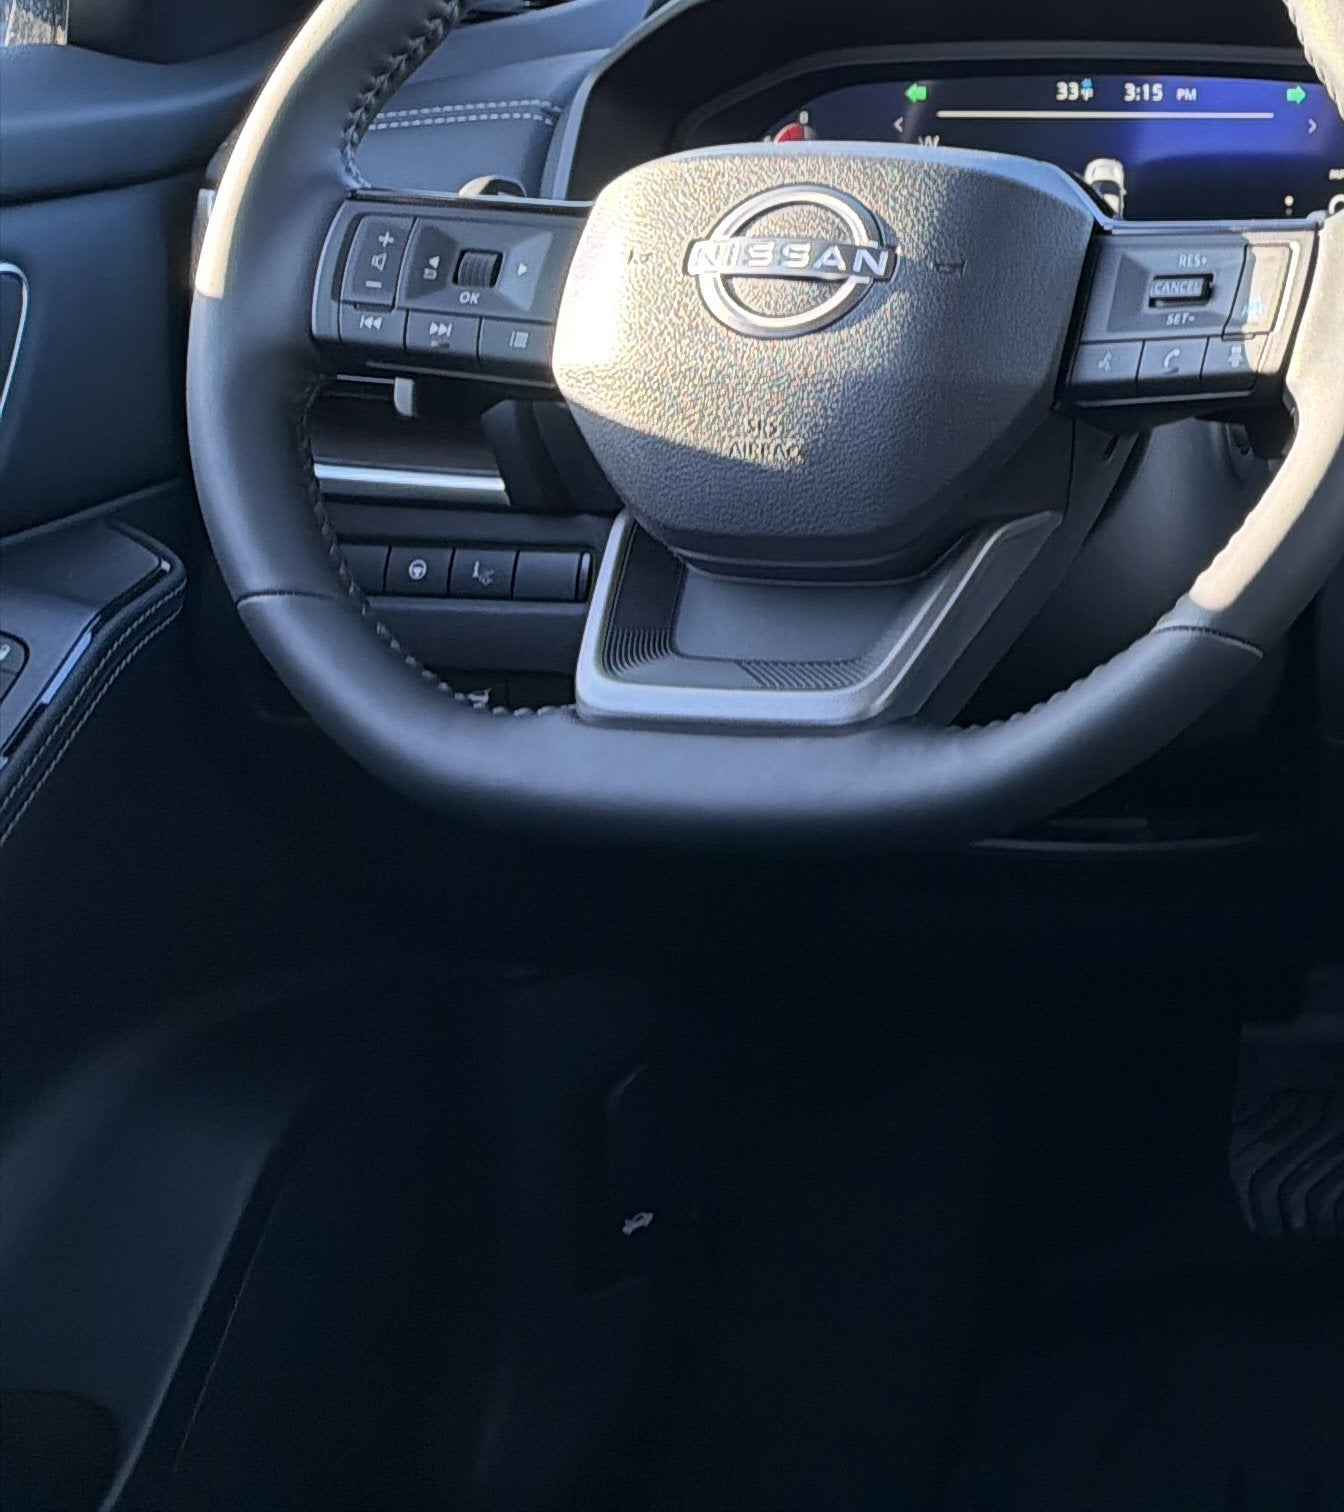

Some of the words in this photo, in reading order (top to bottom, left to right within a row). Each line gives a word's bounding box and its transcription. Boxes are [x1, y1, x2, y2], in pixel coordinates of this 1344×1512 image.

[1124, 82, 1163, 102] 3:15
[1176, 88, 1197, 101] PM
[689, 237, 889, 278] NISSAN
[1154, 279, 1199, 294] CANCEL
[460, 291, 480, 304] OK
